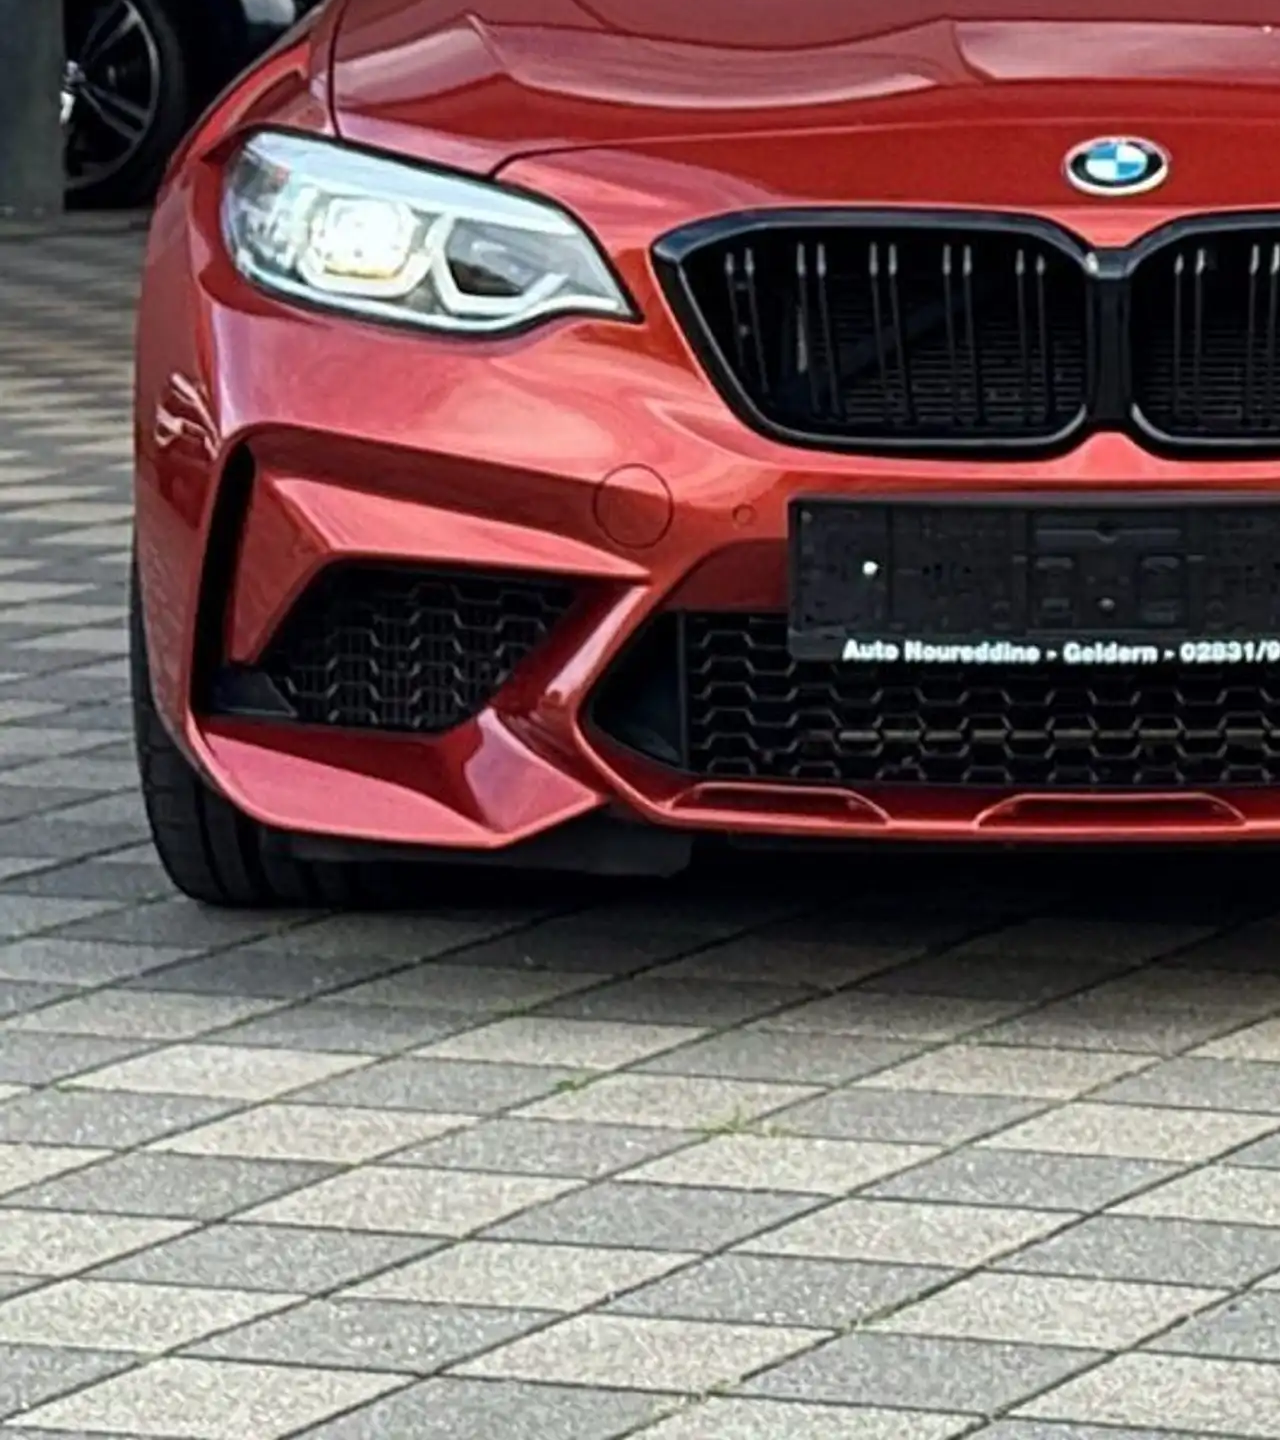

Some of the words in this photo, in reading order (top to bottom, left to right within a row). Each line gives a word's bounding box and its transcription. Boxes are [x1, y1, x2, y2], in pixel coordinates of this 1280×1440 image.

[842, 638, 899, 662] Auto
[904, 639, 1040, 664] Noureddine
[1063, 640, 1159, 664] Geldern
